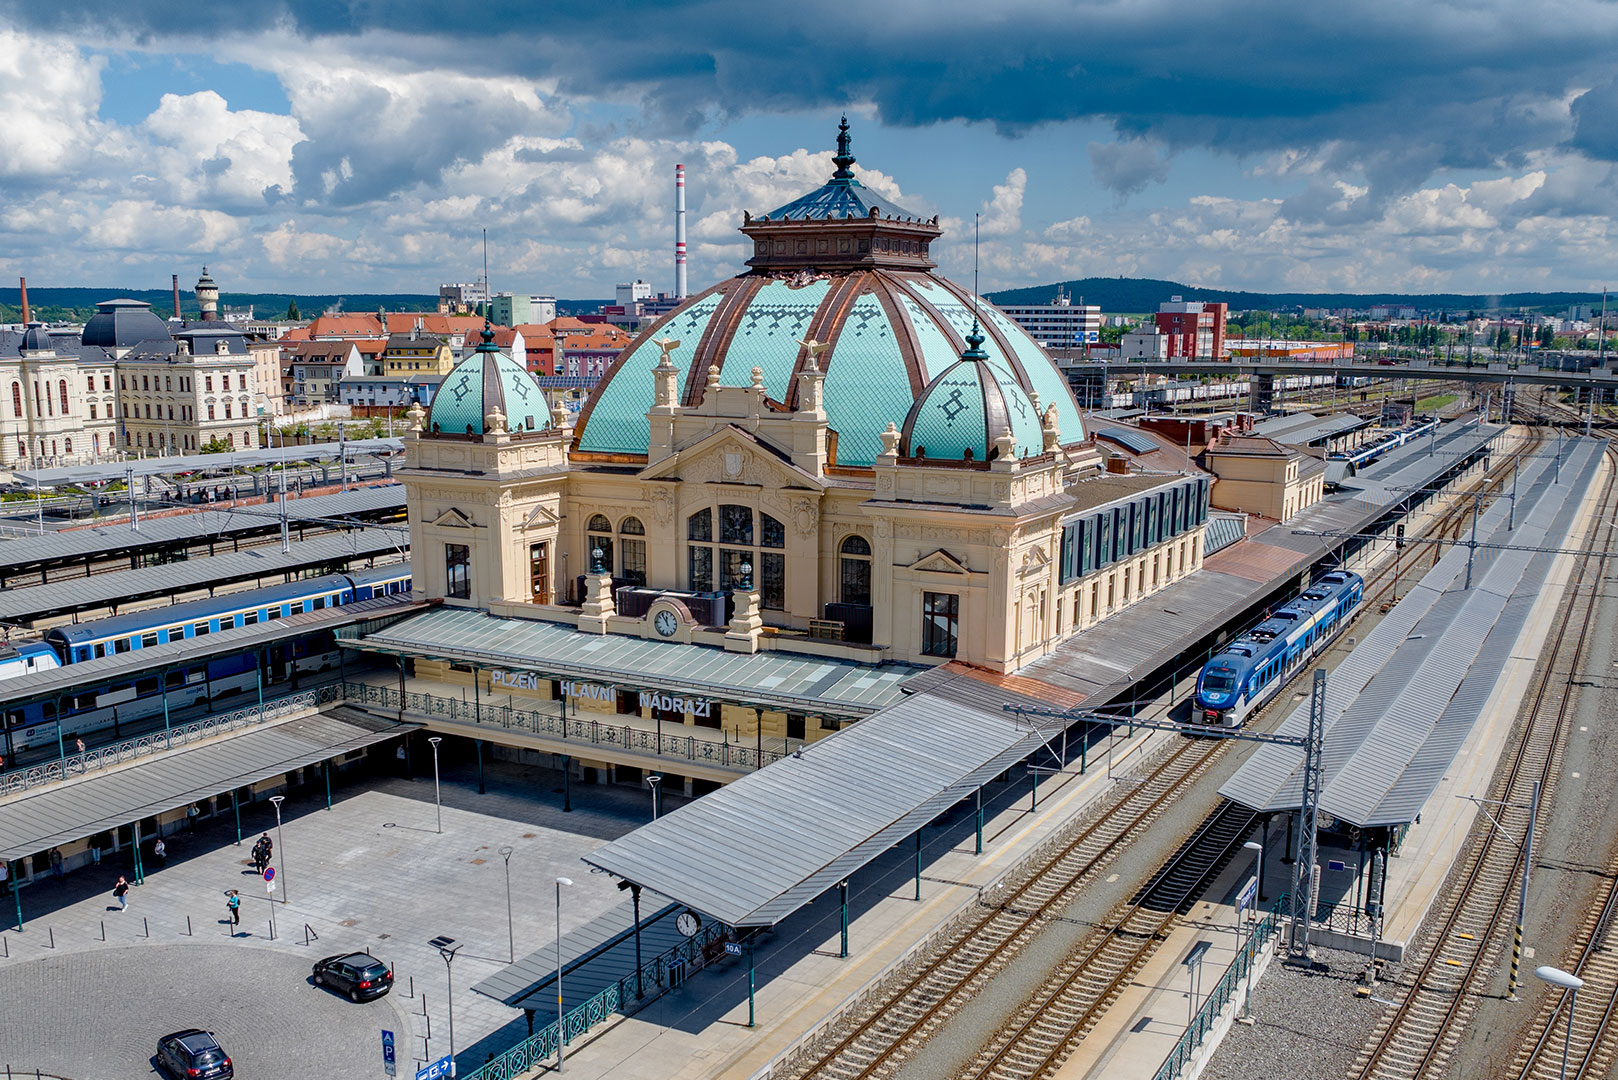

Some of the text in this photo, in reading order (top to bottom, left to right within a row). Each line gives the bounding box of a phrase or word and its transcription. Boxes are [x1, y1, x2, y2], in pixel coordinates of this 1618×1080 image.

[493, 670, 711, 717] PLZEŇ HLAVNÍ NÁDRAŽÍ
[726, 944, 740, 954] 10A
[385, 1046, 393, 1056] P
